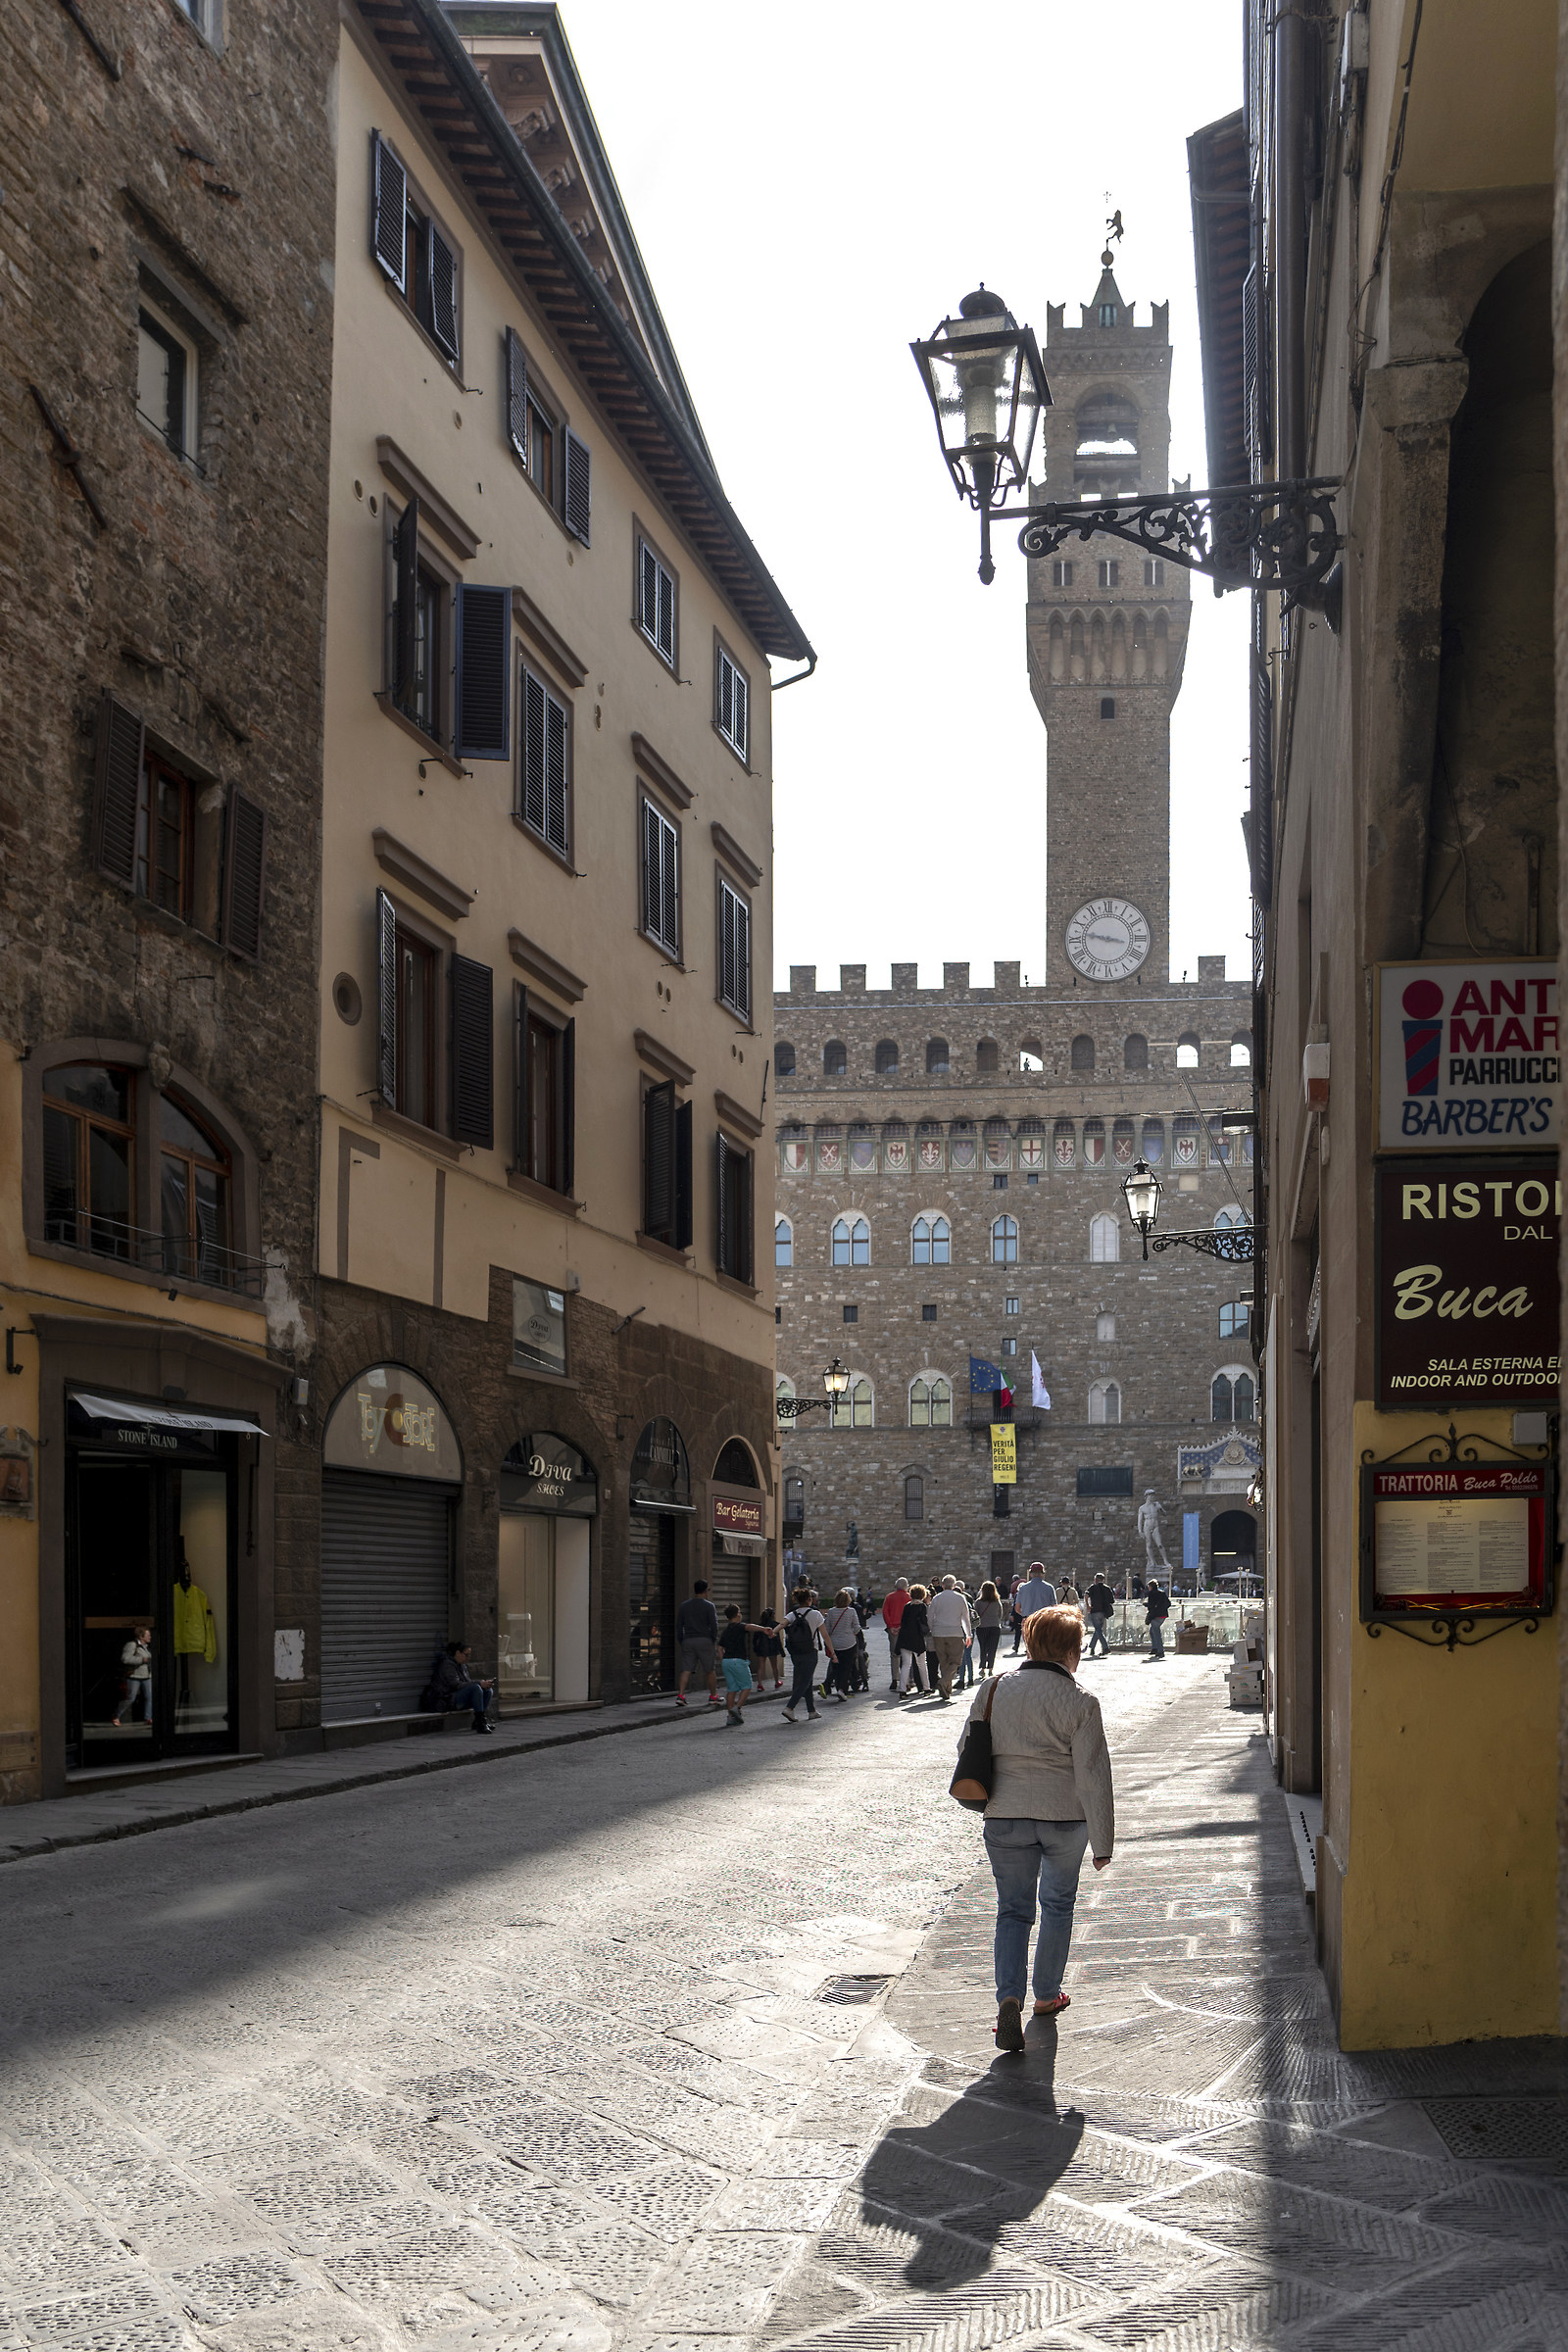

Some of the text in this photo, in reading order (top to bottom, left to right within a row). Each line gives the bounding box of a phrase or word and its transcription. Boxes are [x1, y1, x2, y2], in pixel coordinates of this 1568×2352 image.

[1102, 901, 1113, 913] XII
[1120, 905, 1128, 917] I
[1073, 918, 1086, 929] X
[1130, 917, 1143, 928] II
[1134, 934, 1147, 943] III
[1450, 978, 1556, 1016] ANT
[1449, 1015, 1560, 1053] MAR
[1401, 1097, 1553, 1136] BARBER'S
[1503, 1225, 1553, 1241] DAL
[1393, 1264, 1534, 1320] Buca
[1427, 1358, 1468, 1371] SALA
[1472, 1356, 1544, 1370] ESTERNA
[1391, 1374, 1451, 1388] INDOOR
[1454, 1374, 1488, 1387] AND
[118, 1429, 178, 1449] STONE ISLAND
[993, 1439, 1014, 1447] VERITÀ
[536, 1483, 565, 1496] SHOES
[1379, 1471, 1539, 1493] TRATTORIA Buca Poldo
[715, 1501, 760, 1522] Bar Gelateria
